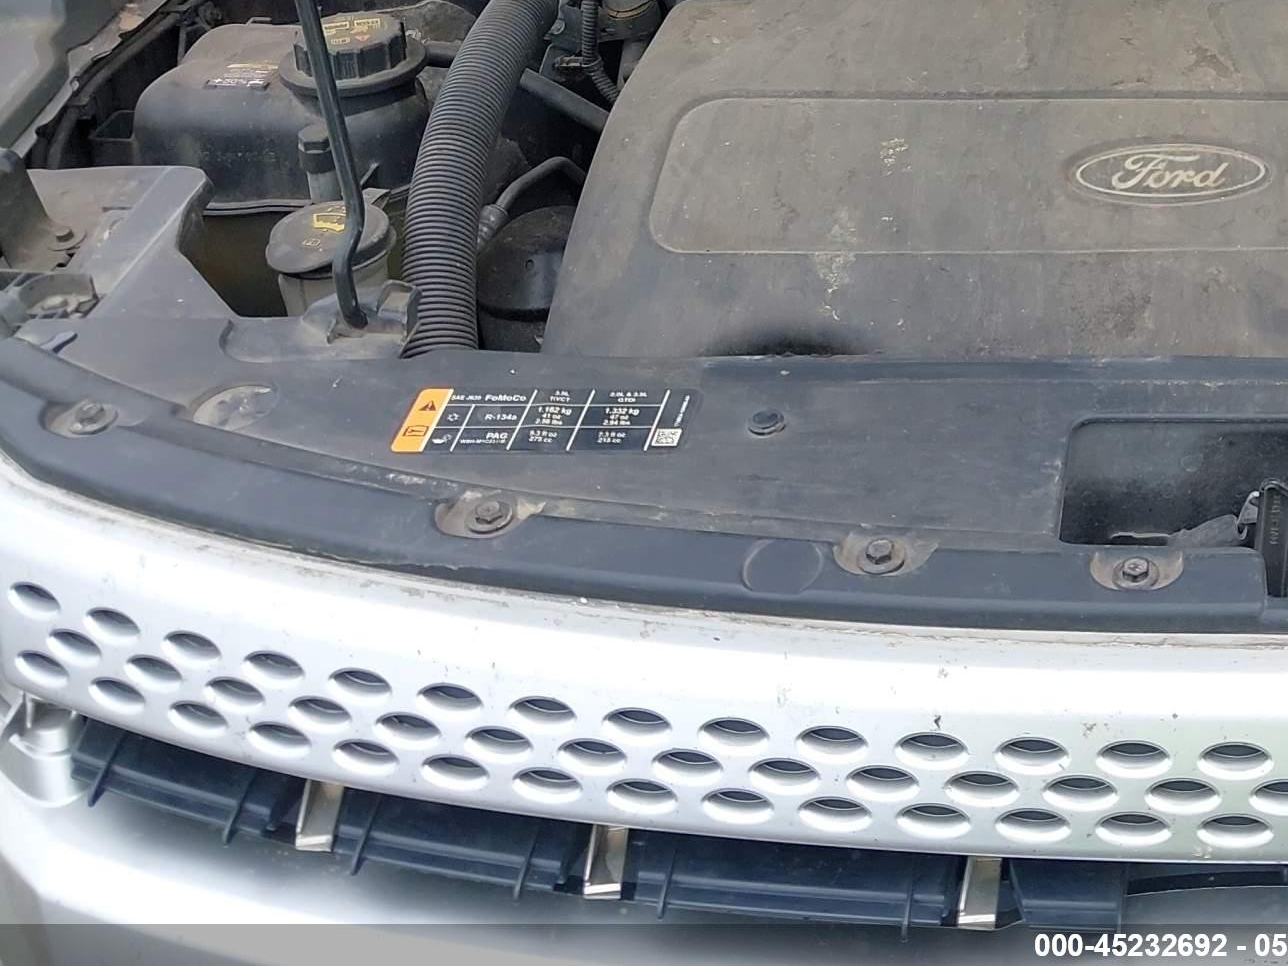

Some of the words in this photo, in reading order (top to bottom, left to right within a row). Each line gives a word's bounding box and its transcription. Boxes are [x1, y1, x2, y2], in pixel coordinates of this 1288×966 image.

[1110, 153, 1229, 190] Ford
[484, 394, 527, 402] FoMoCo
[561, 407, 572, 416] kg
[628, 407, 640, 416] kg
[484, 413, 518, 421] R-134a
